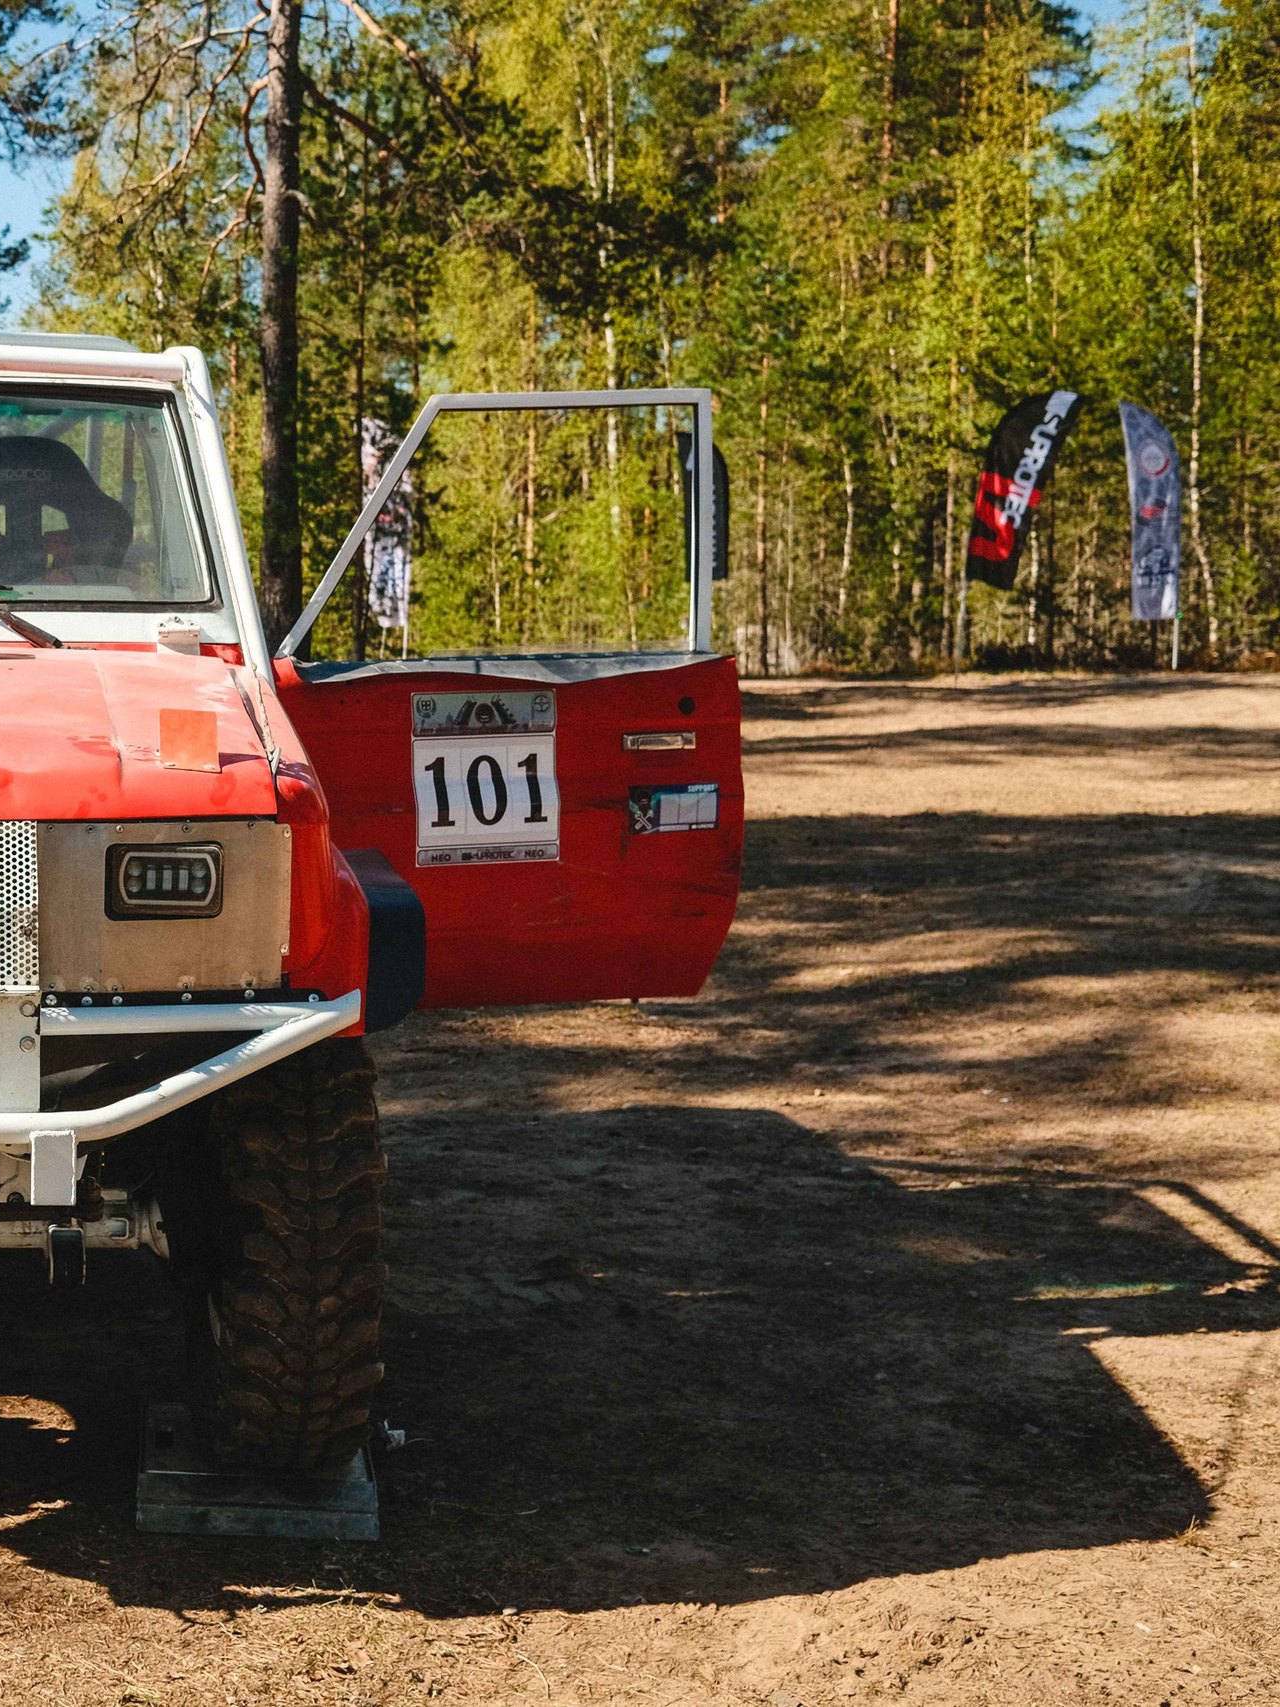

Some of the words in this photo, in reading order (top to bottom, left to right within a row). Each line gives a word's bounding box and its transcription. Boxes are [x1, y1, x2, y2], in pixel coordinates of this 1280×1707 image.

[425, 753, 548, 828] 101
[431, 854, 451, 863] NEO
[524, 849, 544, 859] NEO
